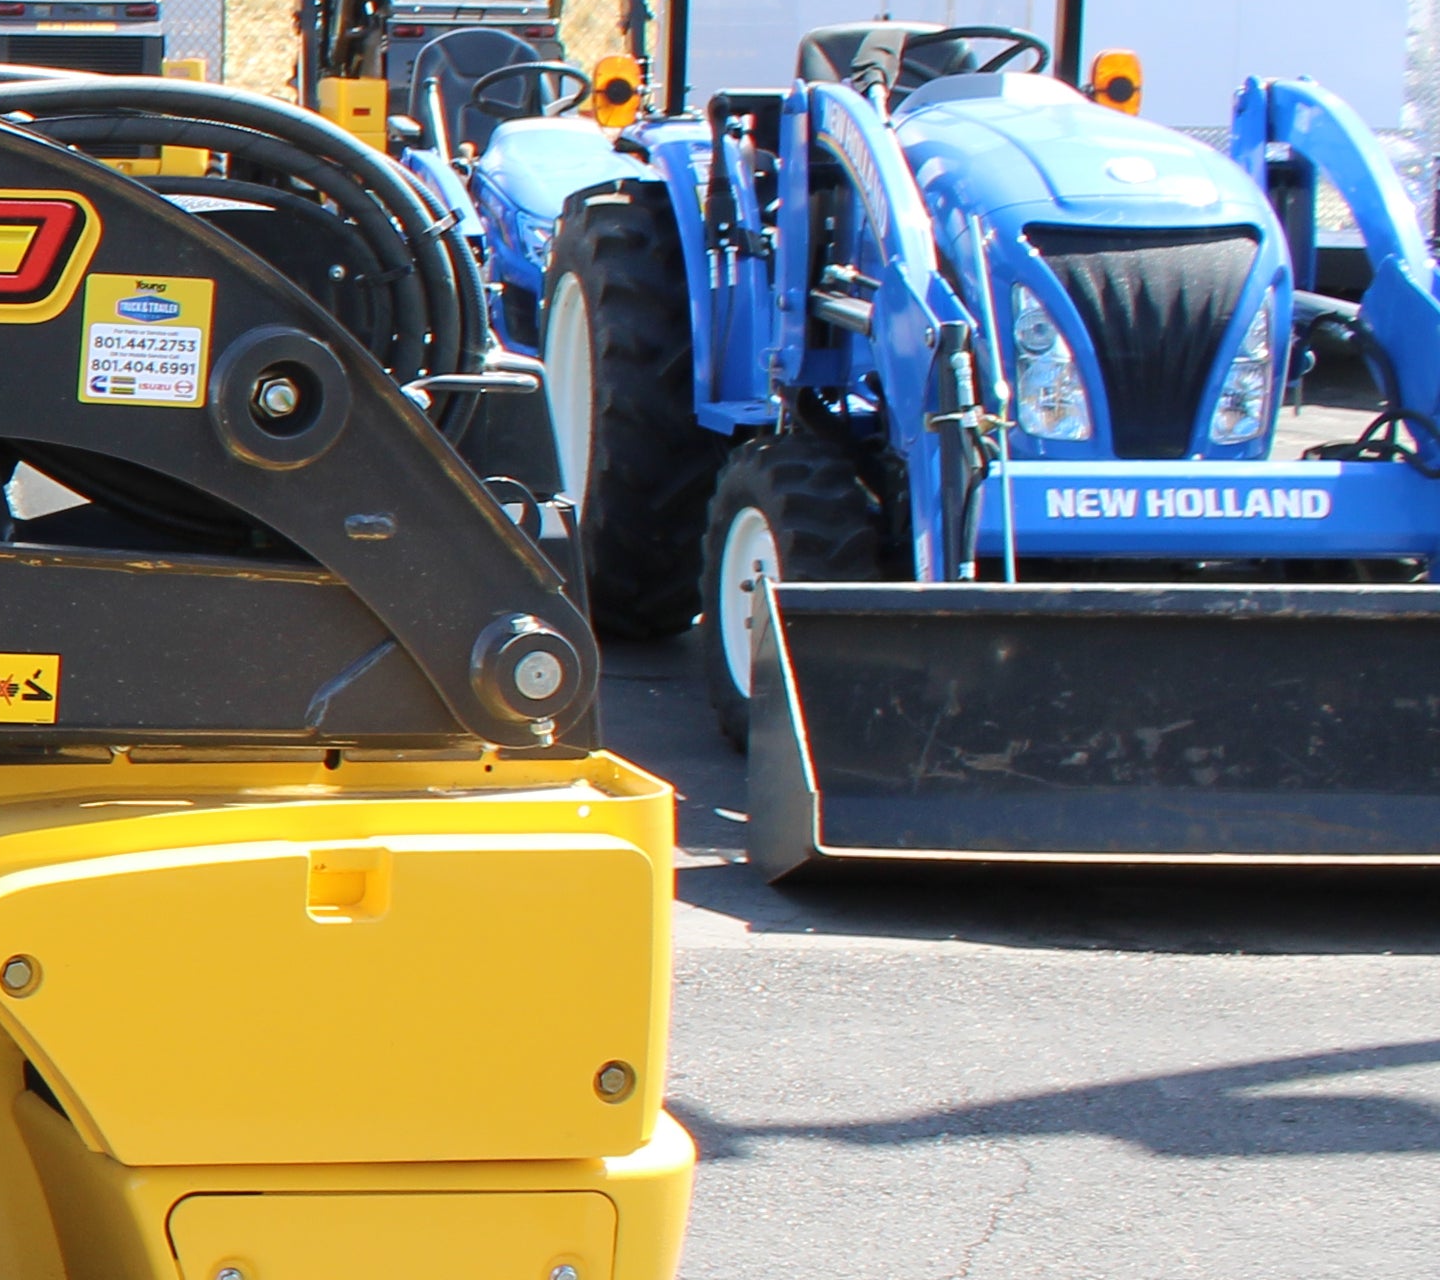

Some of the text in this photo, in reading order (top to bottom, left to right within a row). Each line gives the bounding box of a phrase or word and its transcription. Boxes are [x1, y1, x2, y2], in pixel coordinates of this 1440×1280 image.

[135, 280, 167, 293] Young
[94, 335, 196, 352] 801.447.2753
[91, 358, 196, 375] 801.404.6991
[1045, 488, 1332, 519] NEW HOLLAND
